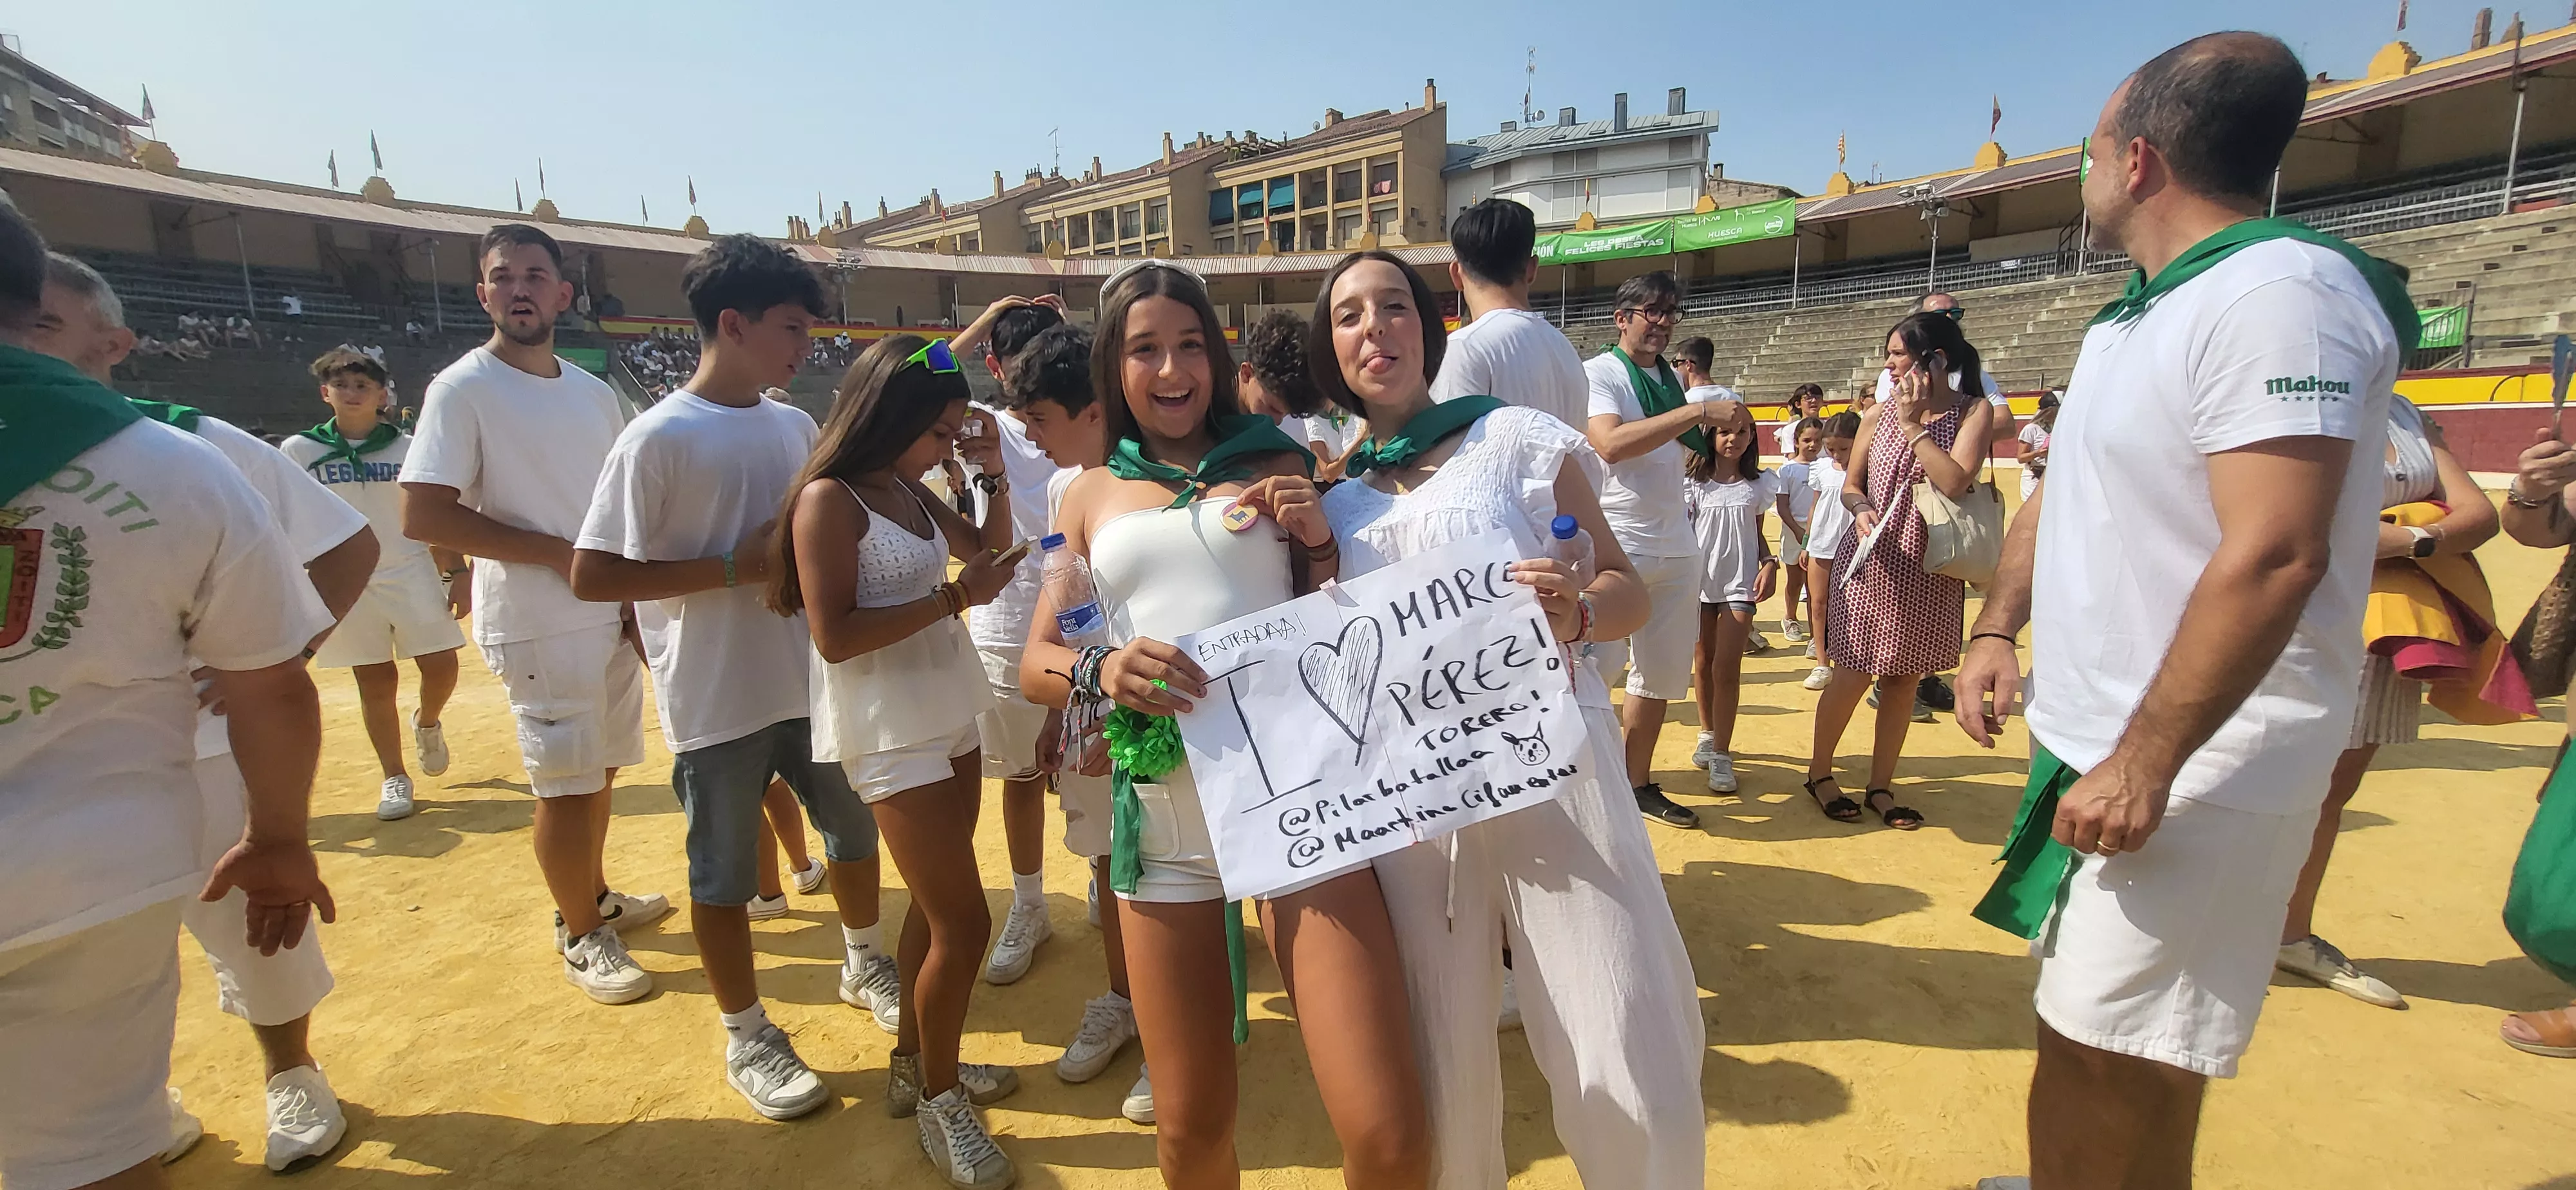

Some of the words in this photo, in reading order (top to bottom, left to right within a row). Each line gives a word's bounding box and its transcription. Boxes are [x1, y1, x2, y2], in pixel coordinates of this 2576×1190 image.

[1607, 234, 1644, 245] DESEA
[1707, 227, 1743, 239] HUESCA
[1565, 244, 1612, 256] FELICES
[1615, 238, 1665, 250] FIESTAS
[2264, 375, 2351, 395] Mahou
[1061, 618, 1077, 627] Font
[1385, 618, 1560, 726] PÉREZ!
[1414, 690, 1550, 751] TORERO!
[1202, 659, 1323, 814] I
